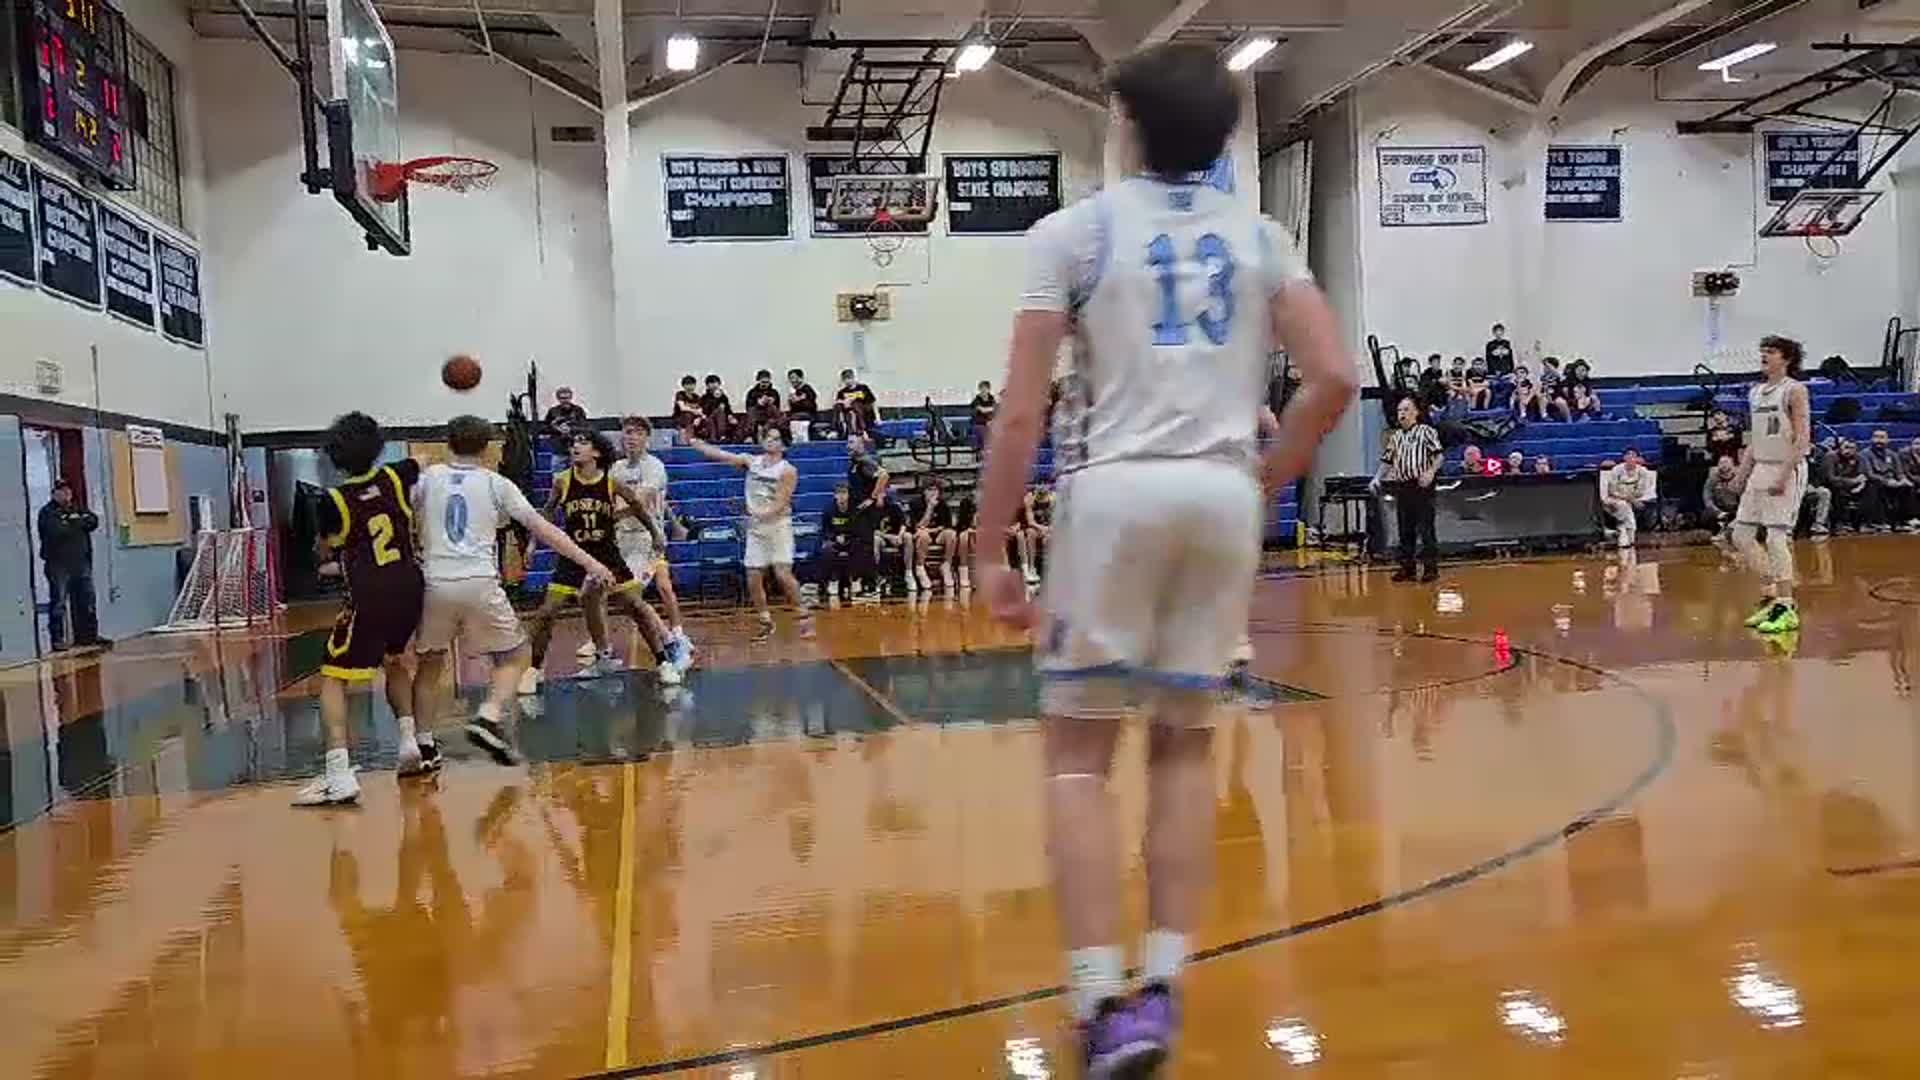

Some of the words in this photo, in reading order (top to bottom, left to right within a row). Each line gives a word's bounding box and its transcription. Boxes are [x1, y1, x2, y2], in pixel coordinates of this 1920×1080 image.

[953, 161, 987, 177] BOYS
[957, 182, 990, 197] STATE
[1147, 232, 1236, 346] 13
[445, 493, 468, 546] 0
[582, 512, 597, 529] 11
[367, 513, 400, 567] 2
